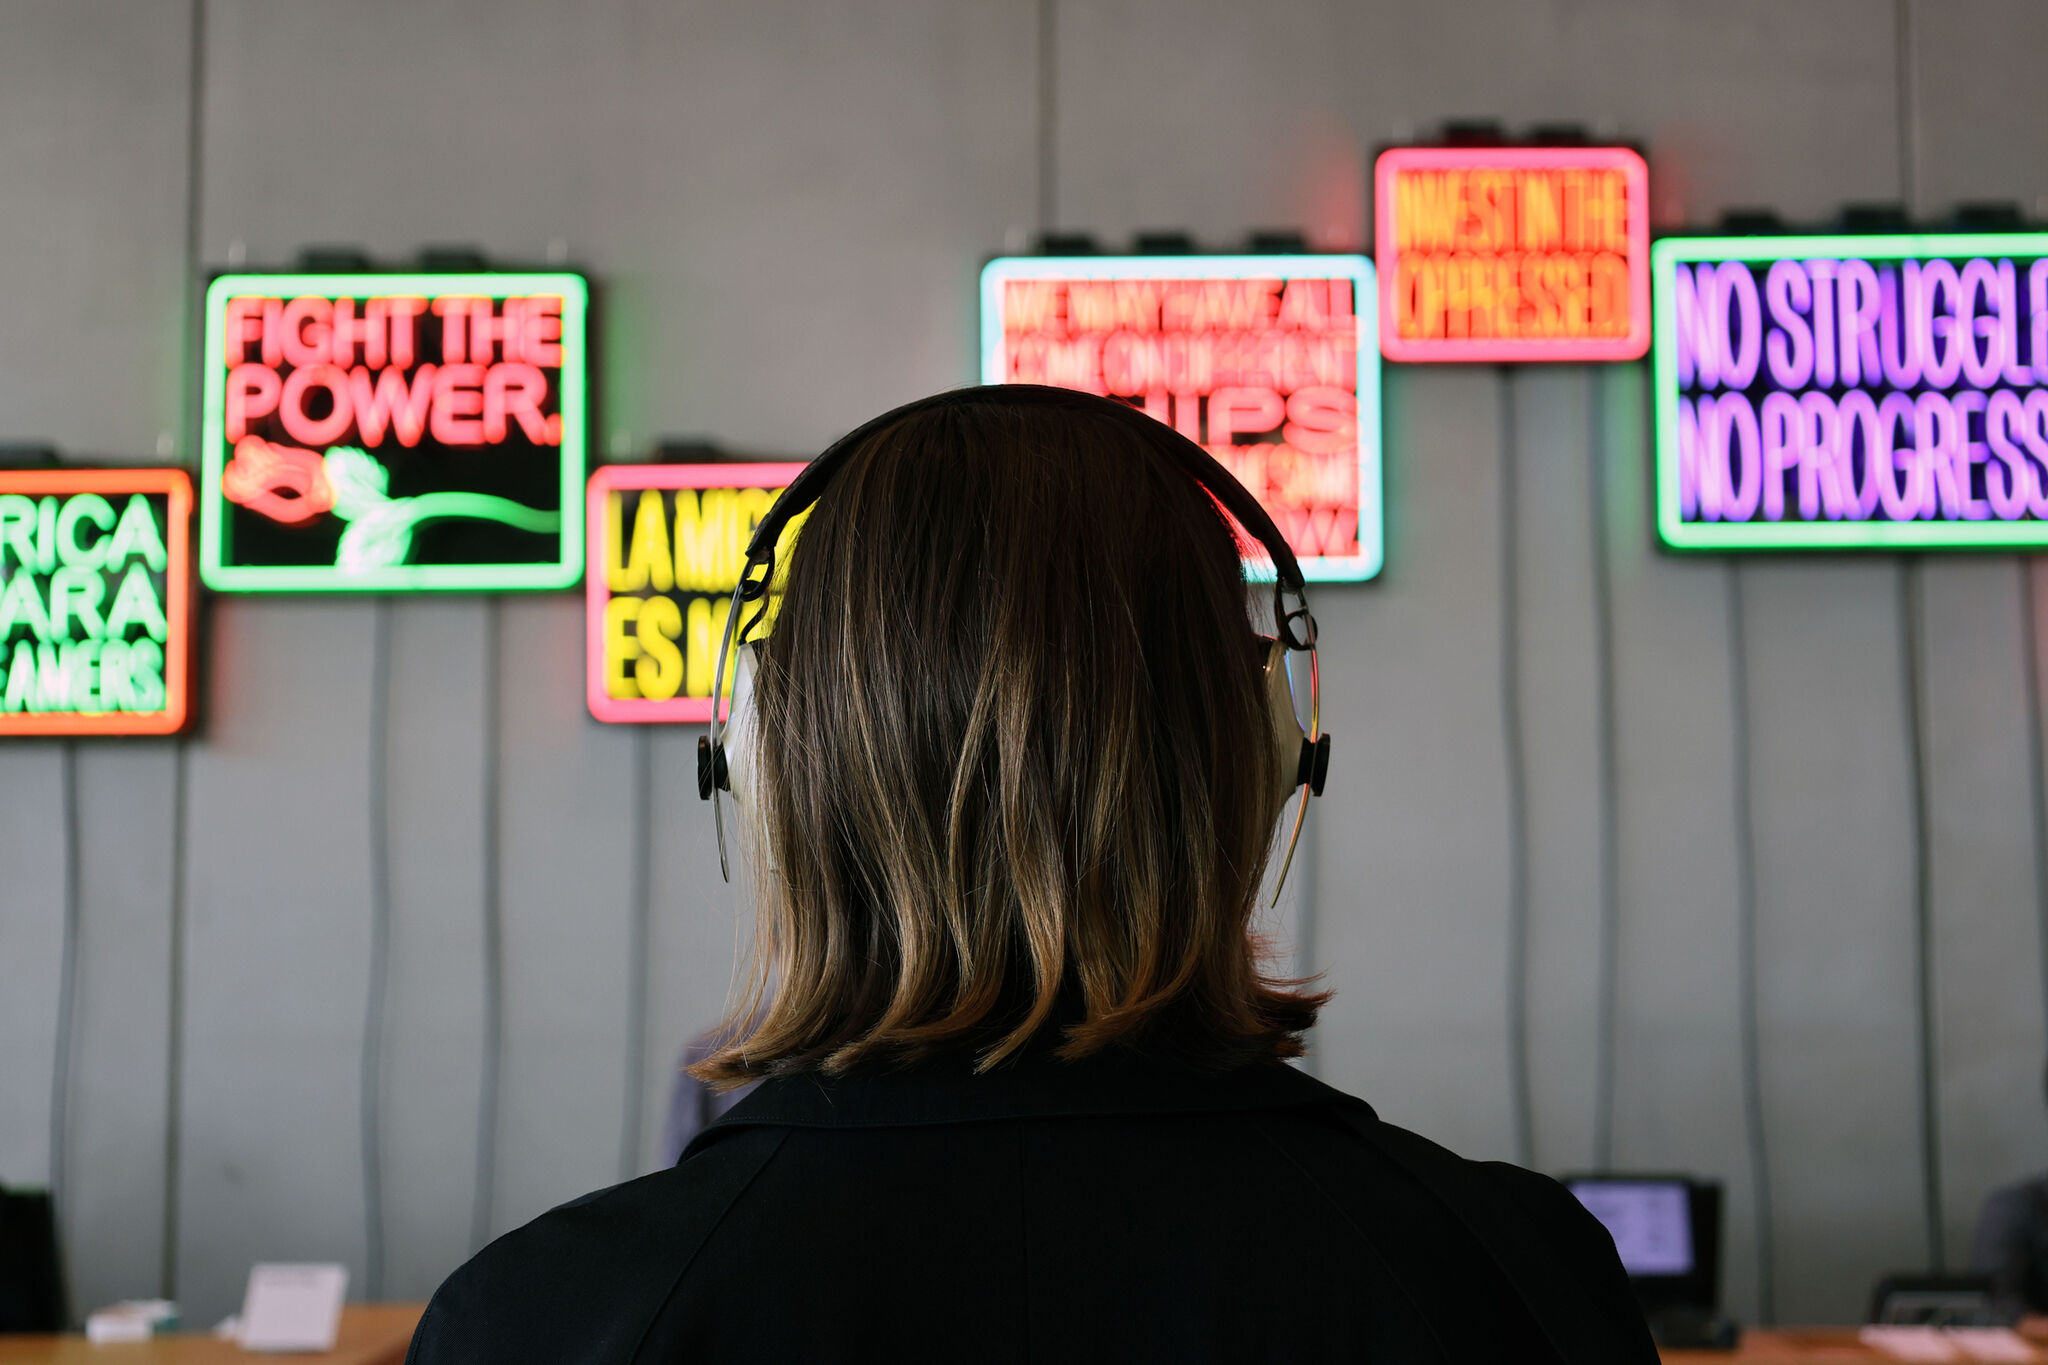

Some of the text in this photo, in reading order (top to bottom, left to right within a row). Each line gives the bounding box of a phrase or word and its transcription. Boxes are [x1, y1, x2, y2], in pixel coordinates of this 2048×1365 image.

[225, 293, 565, 371] FIGHT THE
[1675, 259, 1762, 391] NO
[225, 361, 565, 448] POWER.
[1146, 386, 1363, 456] IPS
[1678, 391, 1763, 523] NO
[604, 487, 674, 593] LA
[0, 561, 169, 643] ARA
[604, 595, 684, 702] ES
